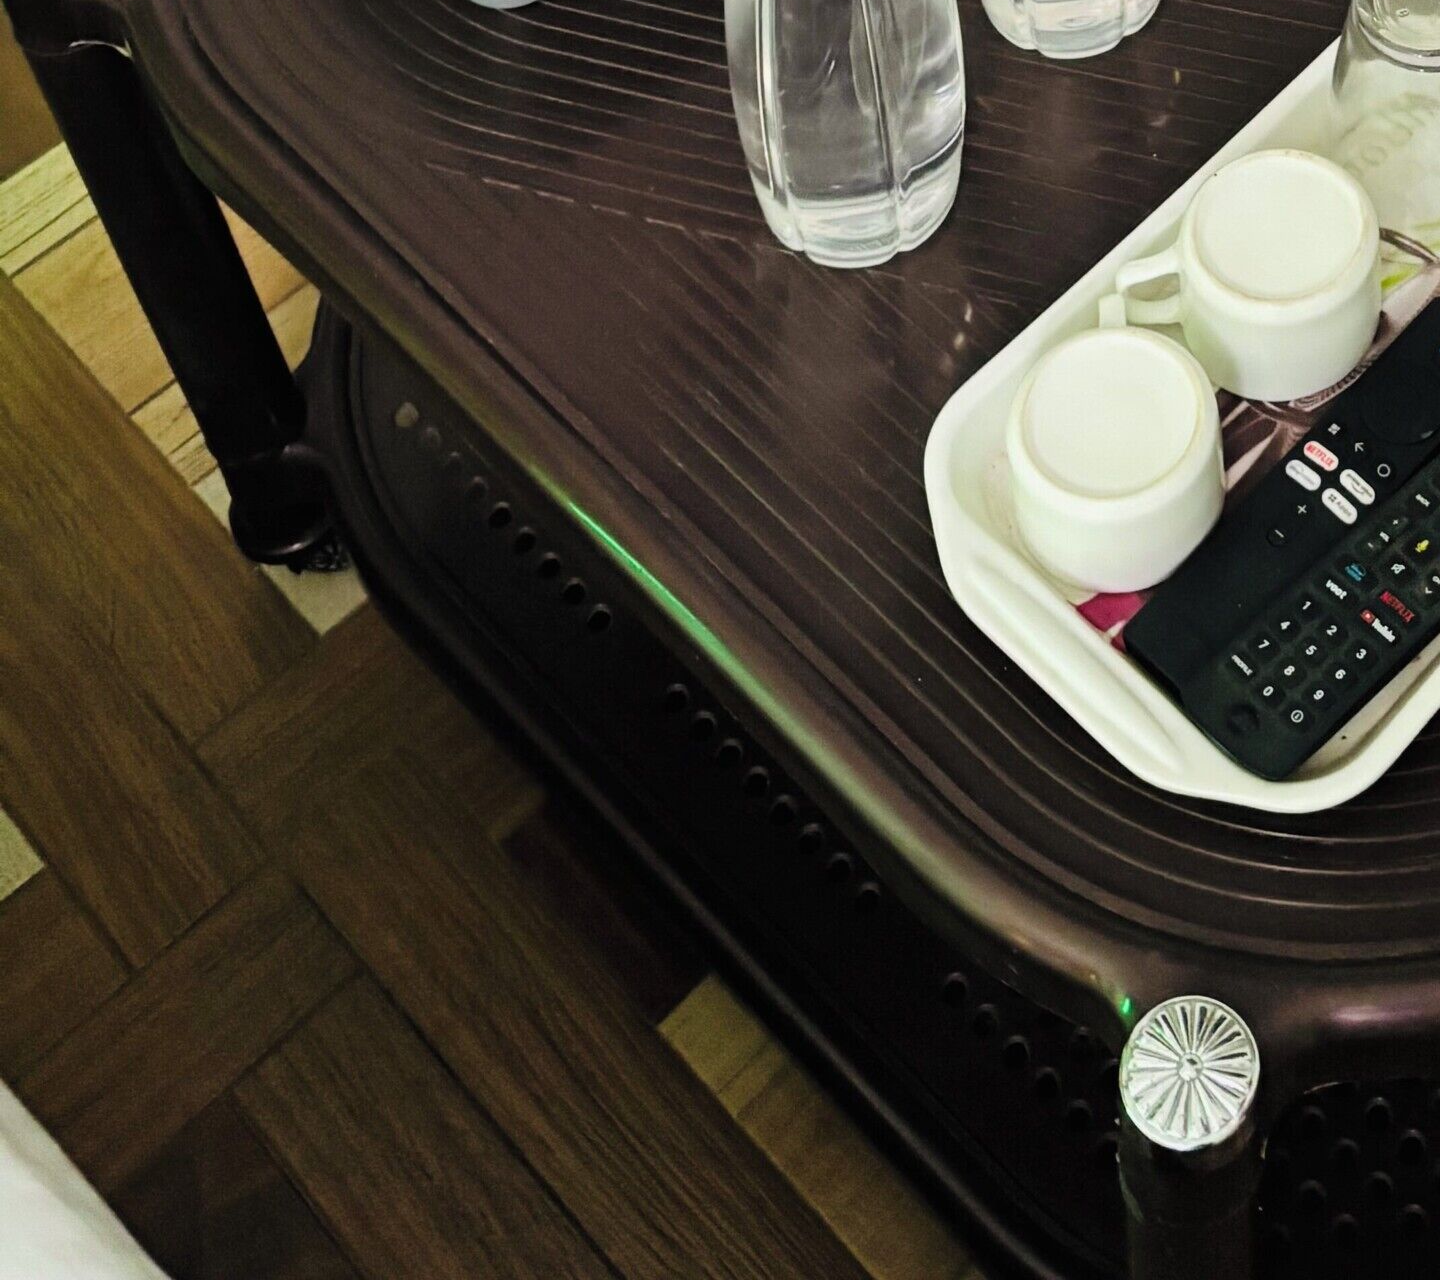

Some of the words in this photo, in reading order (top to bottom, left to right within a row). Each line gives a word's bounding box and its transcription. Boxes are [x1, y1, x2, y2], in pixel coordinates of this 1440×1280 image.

[1302, 600, 1312, 611] 1
[1326, 624, 1338, 636] 2
[1355, 648, 1367, 660] 3
[1379, 591, 1415, 623] NETFLIX
[1257, 639, 1270, 649] 7
[1283, 665, 1295, 676] 8
[1313, 689, 1325, 701] 9
[1280, 620, 1291, 631] 4
[1305, 644, 1318, 656] 5
[1335, 668, 1347, 680] 6
[1262, 685, 1274, 697] 0
